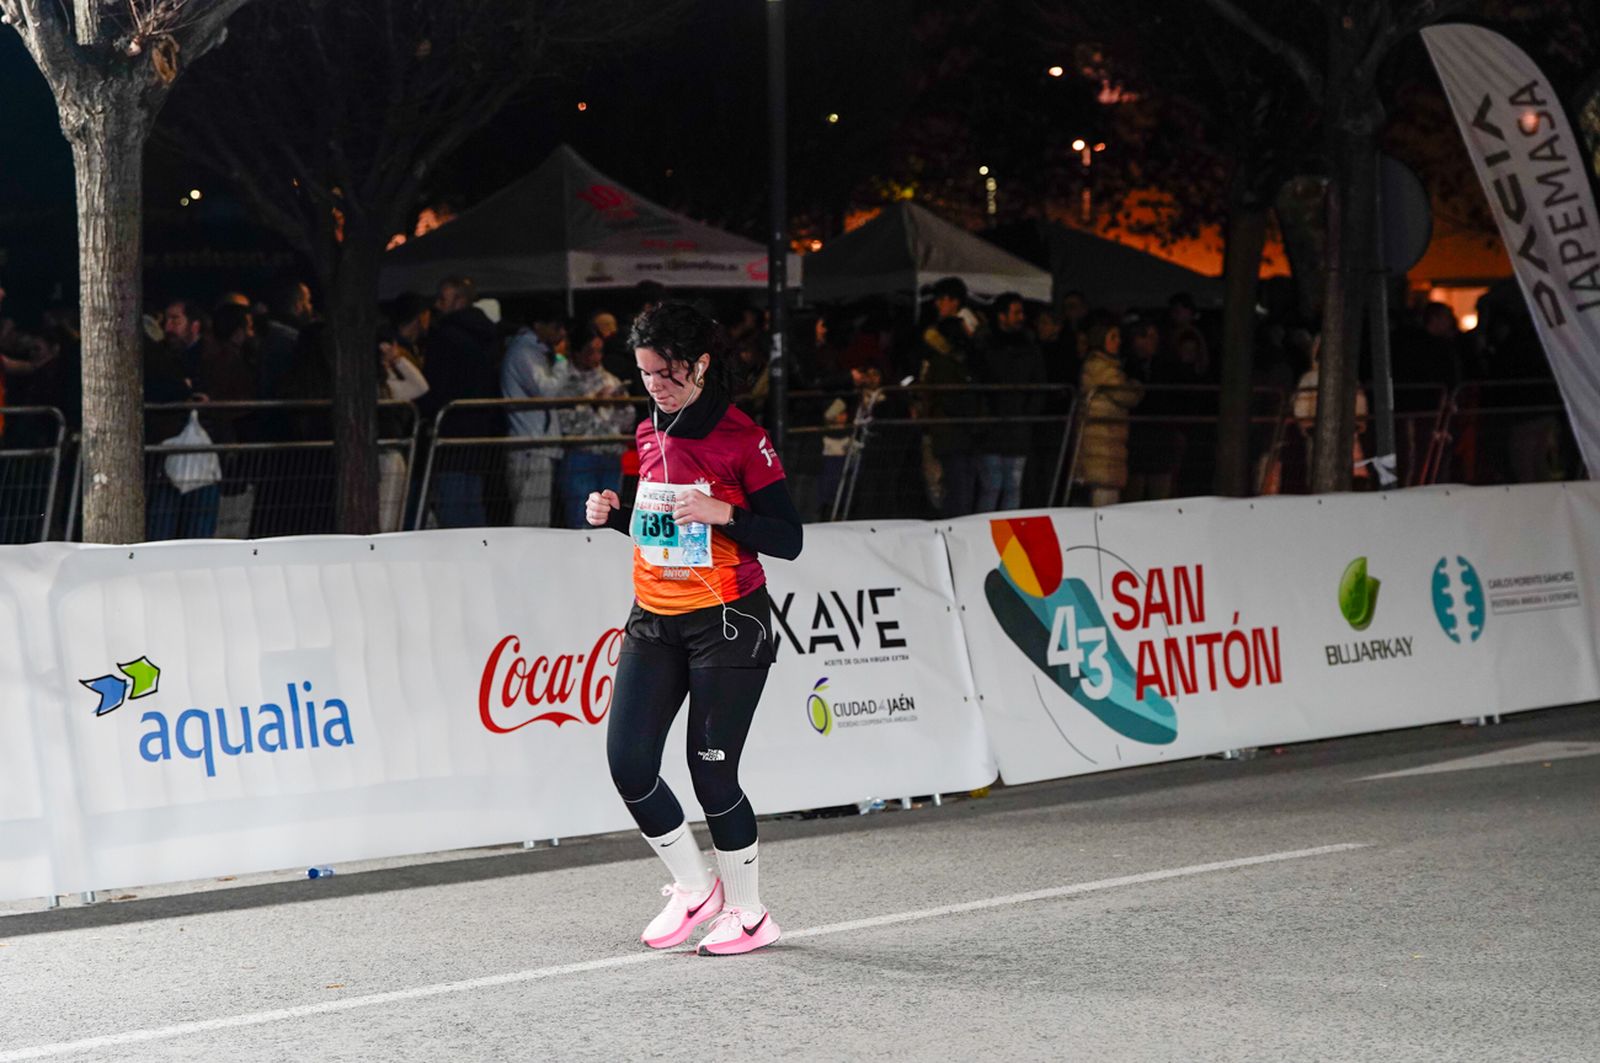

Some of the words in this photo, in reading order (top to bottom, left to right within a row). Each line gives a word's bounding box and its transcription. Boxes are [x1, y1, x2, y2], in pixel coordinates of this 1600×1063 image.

[641, 513, 675, 538] 136
[1111, 563, 1205, 632] SAN
[478, 628, 625, 733] Coca-C
[853, 657, 869, 665] OLIVA
[869, 656, 890, 664] VIRGEN
[891, 654, 909, 662] EXTRA
[1046, 605, 1114, 701] 43
[1135, 611, 1282, 702] ANTÓN
[138, 681, 355, 777] aqualia
[833, 699, 877, 717] CIUDAD
[887, 693, 915, 715] JAÉN
